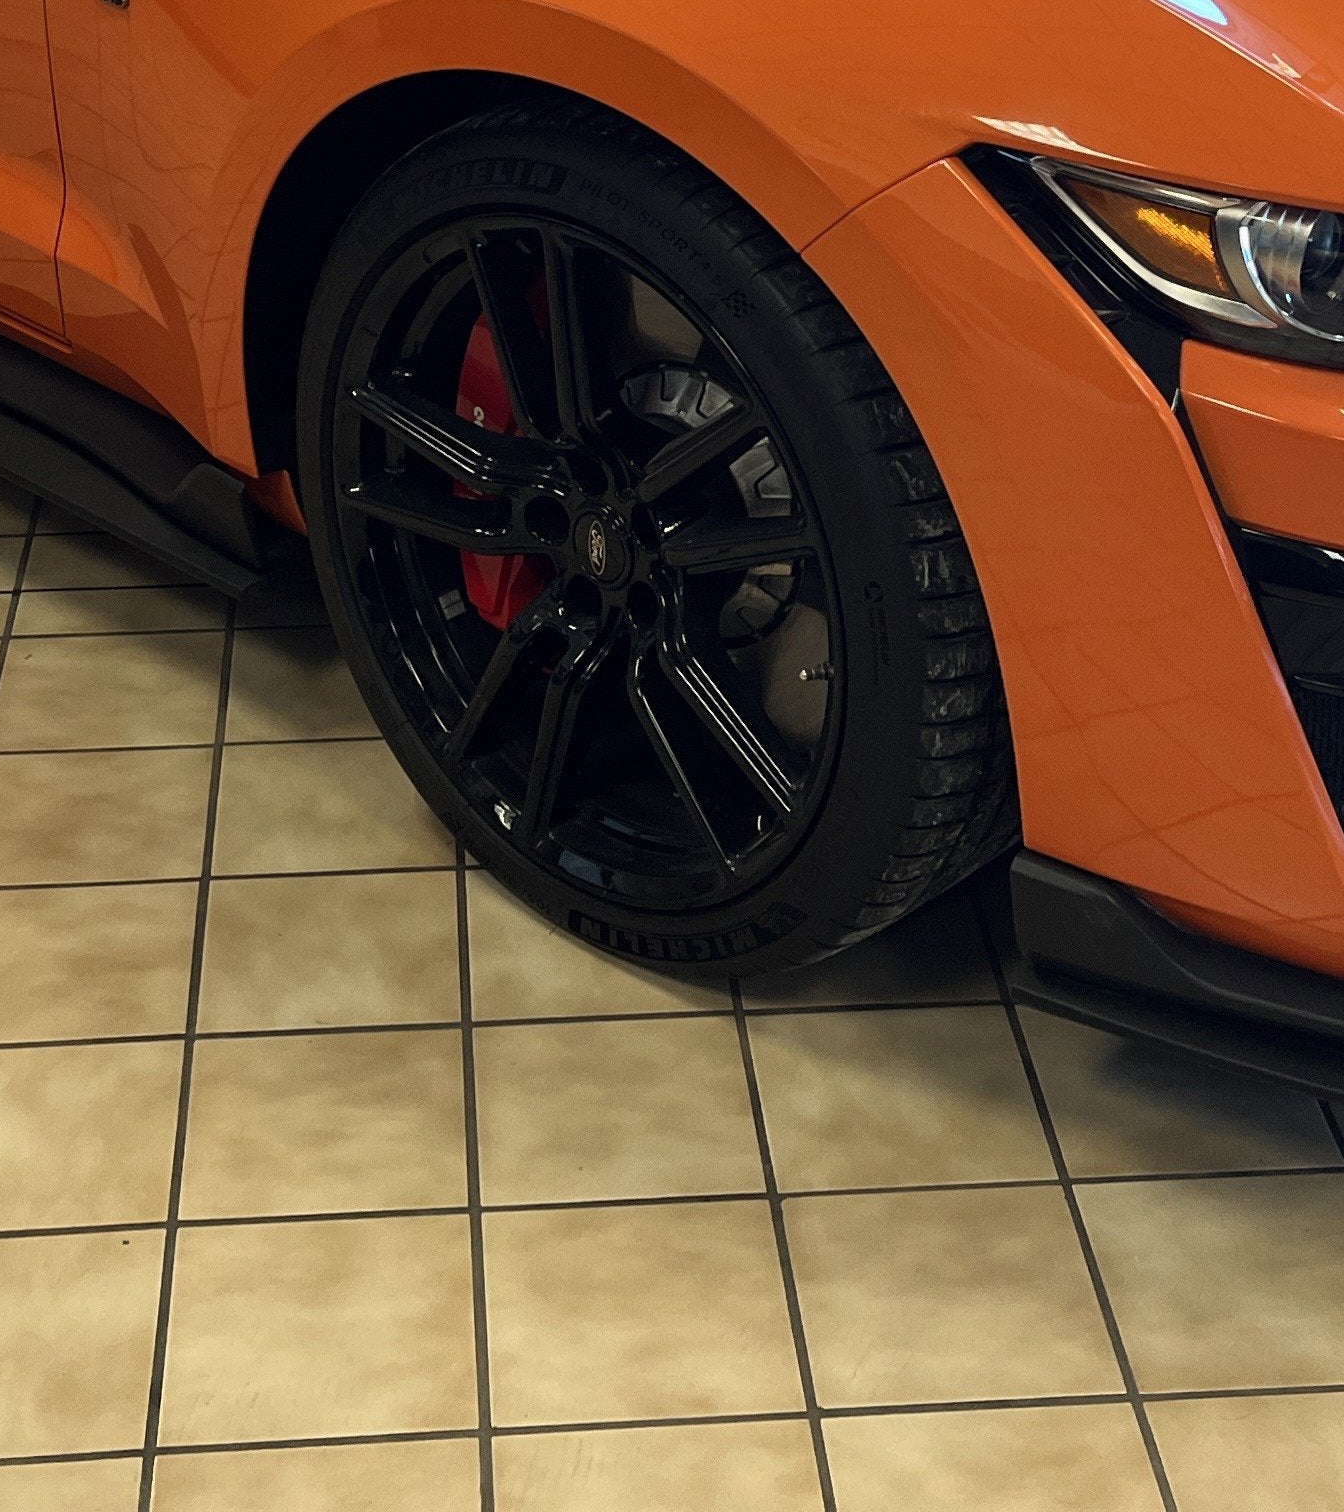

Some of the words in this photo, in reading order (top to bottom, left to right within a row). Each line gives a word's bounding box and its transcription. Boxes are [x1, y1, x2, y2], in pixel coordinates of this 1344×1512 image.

[579, 178, 630, 211] PILOT
[638, 210, 704, 264] SPORT
[579, 916, 758, 960] MICHELIN
